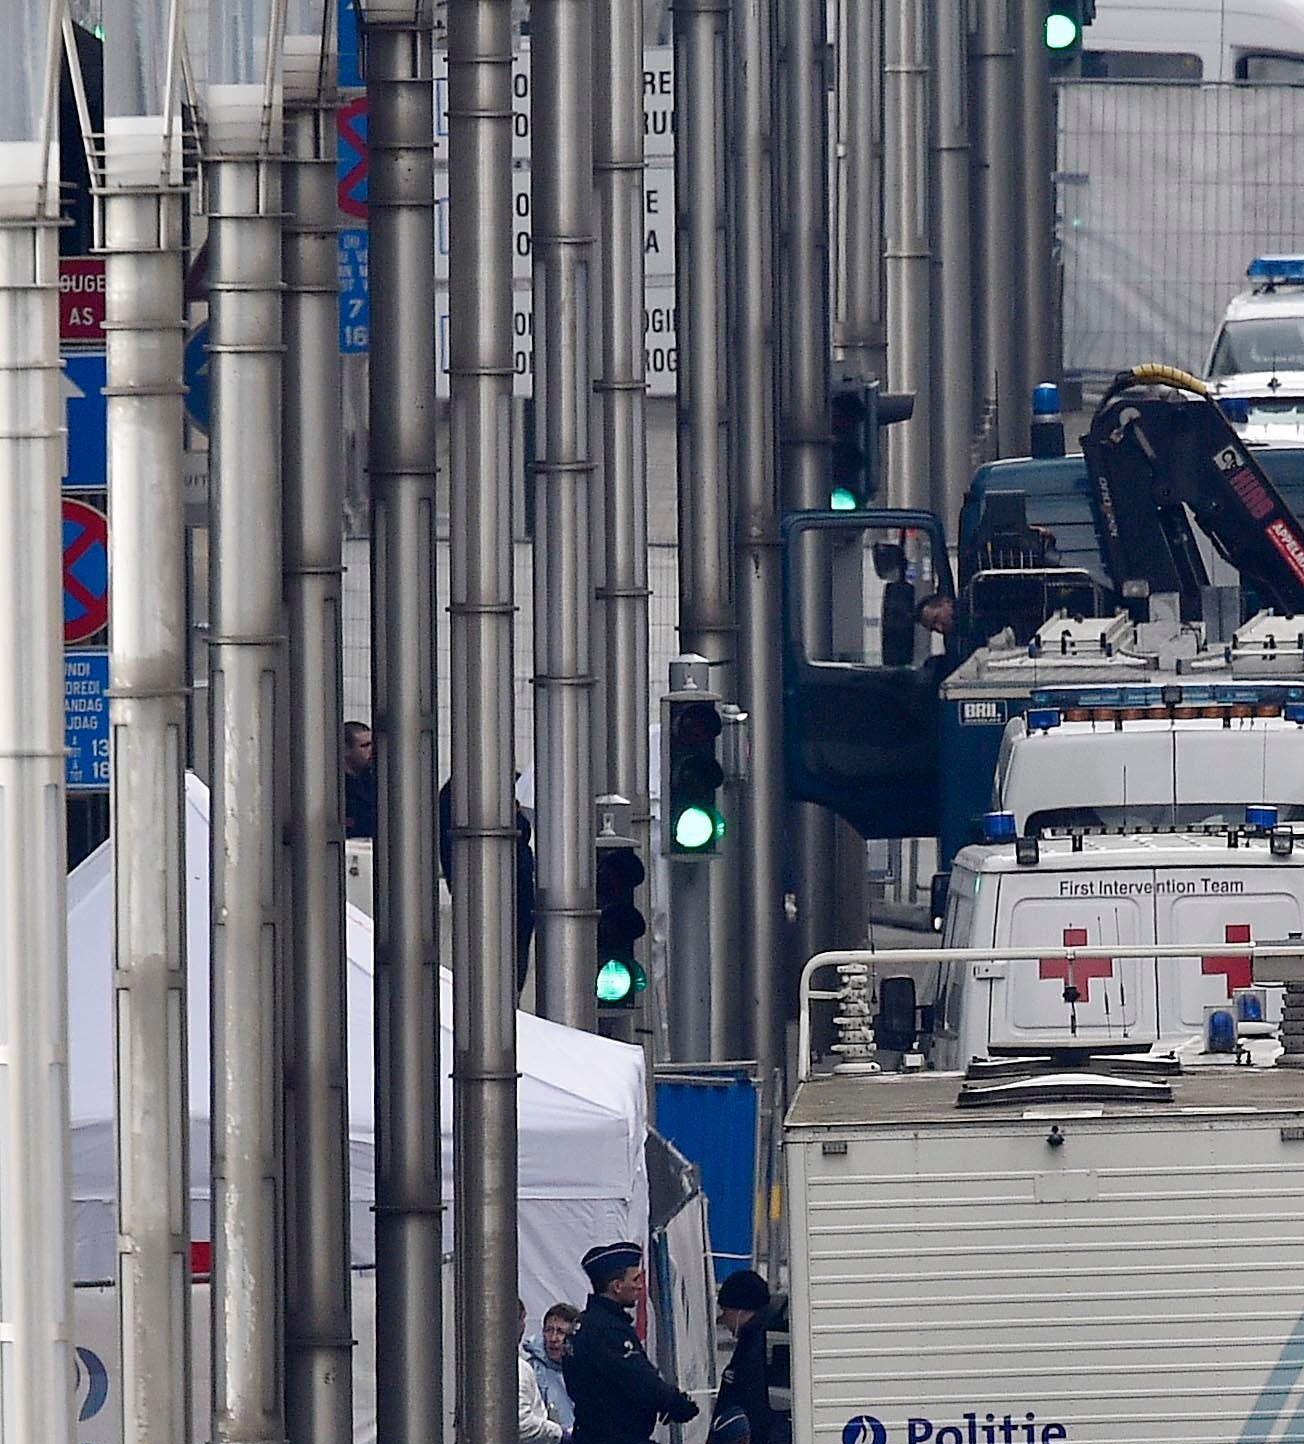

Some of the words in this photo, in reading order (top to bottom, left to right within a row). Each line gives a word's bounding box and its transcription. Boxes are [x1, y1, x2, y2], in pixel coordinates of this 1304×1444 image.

[1060, 880, 1091, 896] First
[1099, 878, 1196, 896] Intervention
[1201, 879, 1244, 894] Team
